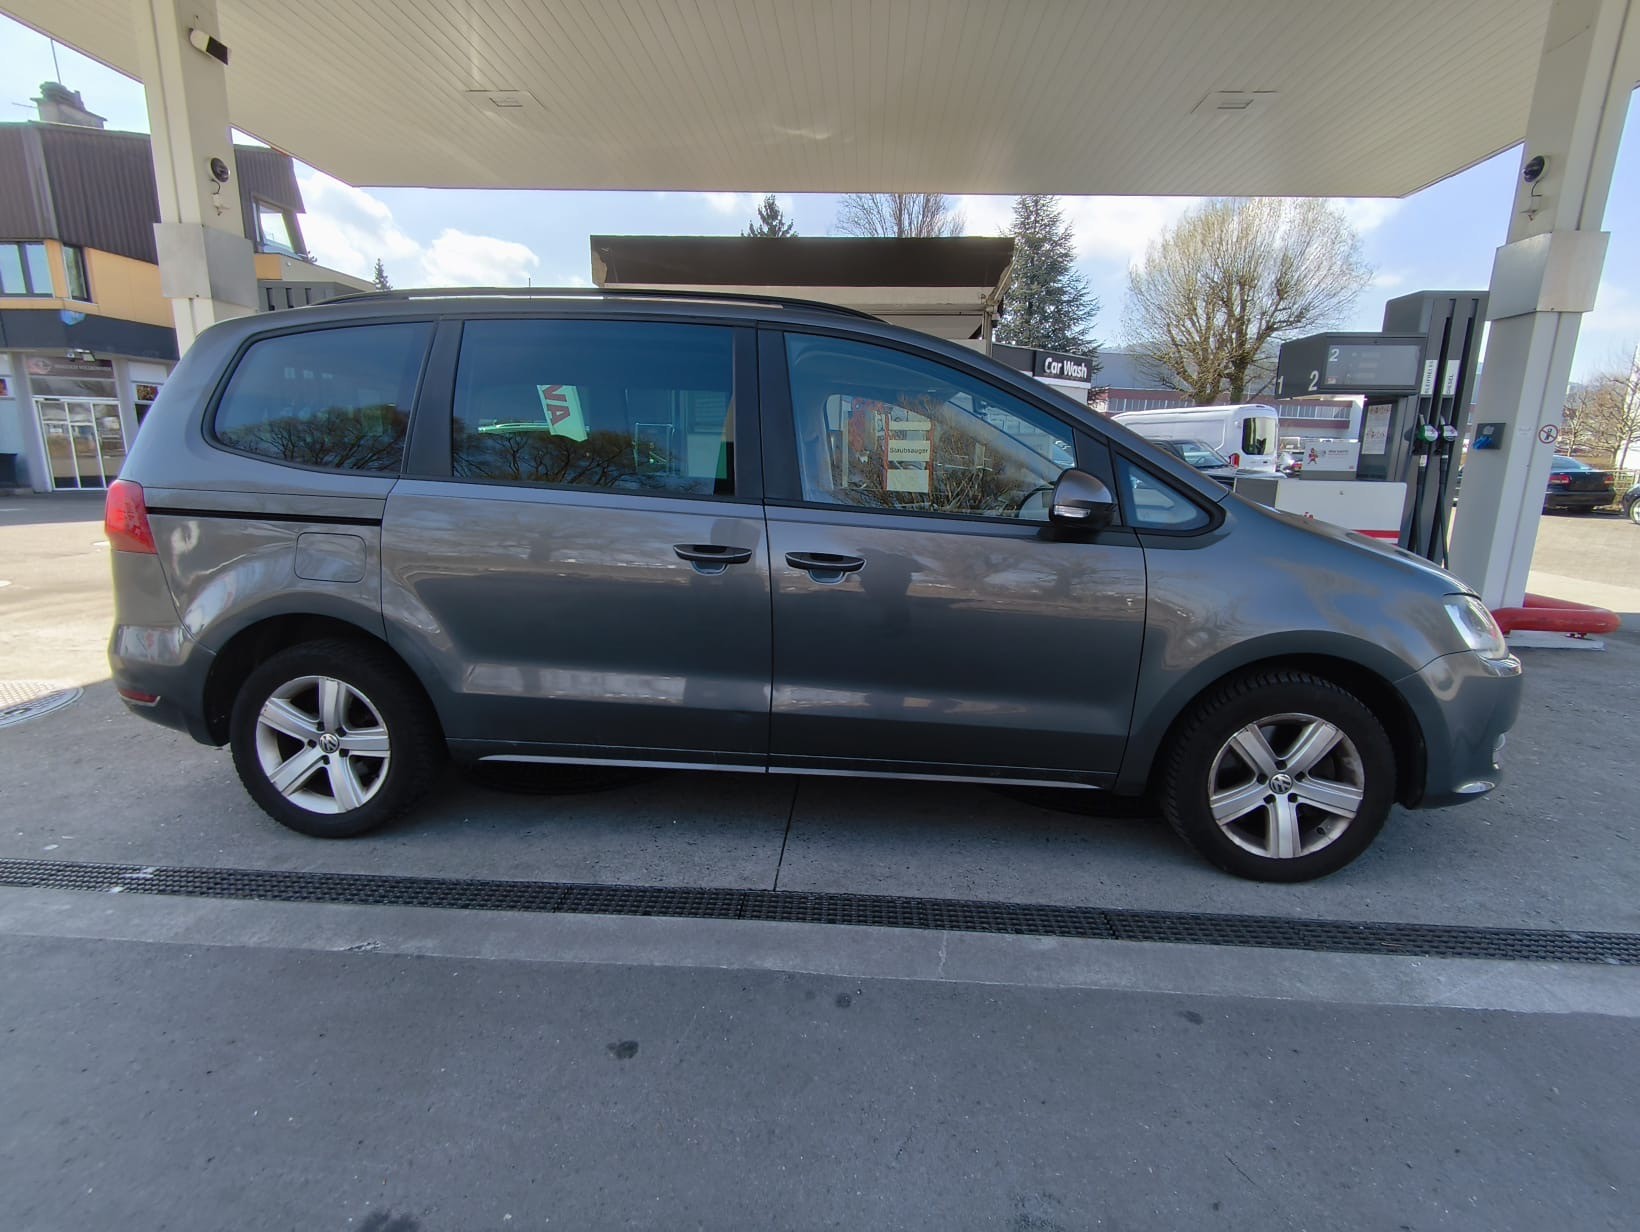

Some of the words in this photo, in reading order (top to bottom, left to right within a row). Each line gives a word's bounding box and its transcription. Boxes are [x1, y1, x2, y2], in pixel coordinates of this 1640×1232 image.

[1328, 348, 1340, 362] 2
[1044, 357, 1062, 375] Car
[1063, 360, 1088, 379] Wash
[1277, 376, 1284, 395] 1
[1308, 370, 1319, 391] 2
